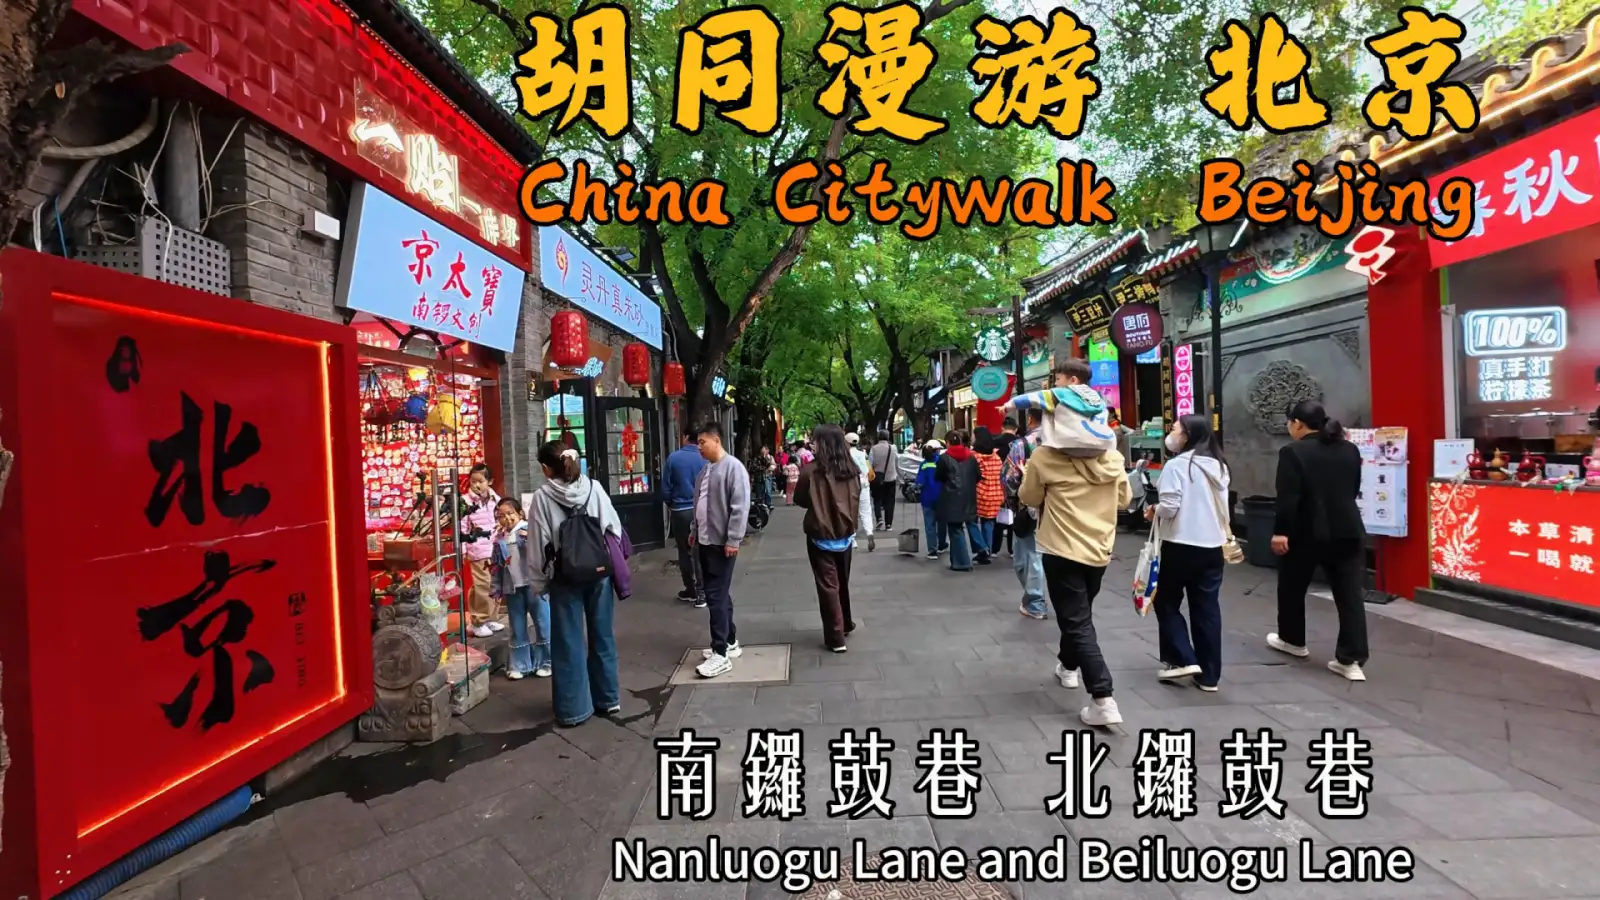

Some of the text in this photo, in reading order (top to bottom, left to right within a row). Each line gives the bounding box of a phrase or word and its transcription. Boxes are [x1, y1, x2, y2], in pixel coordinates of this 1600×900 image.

[1473, 315, 1558, 348] 100%
[1479, 356, 1554, 380] 真手打
[137, 390, 277, 733] 北京
[1508, 548, 1595, 575] 一喝就
